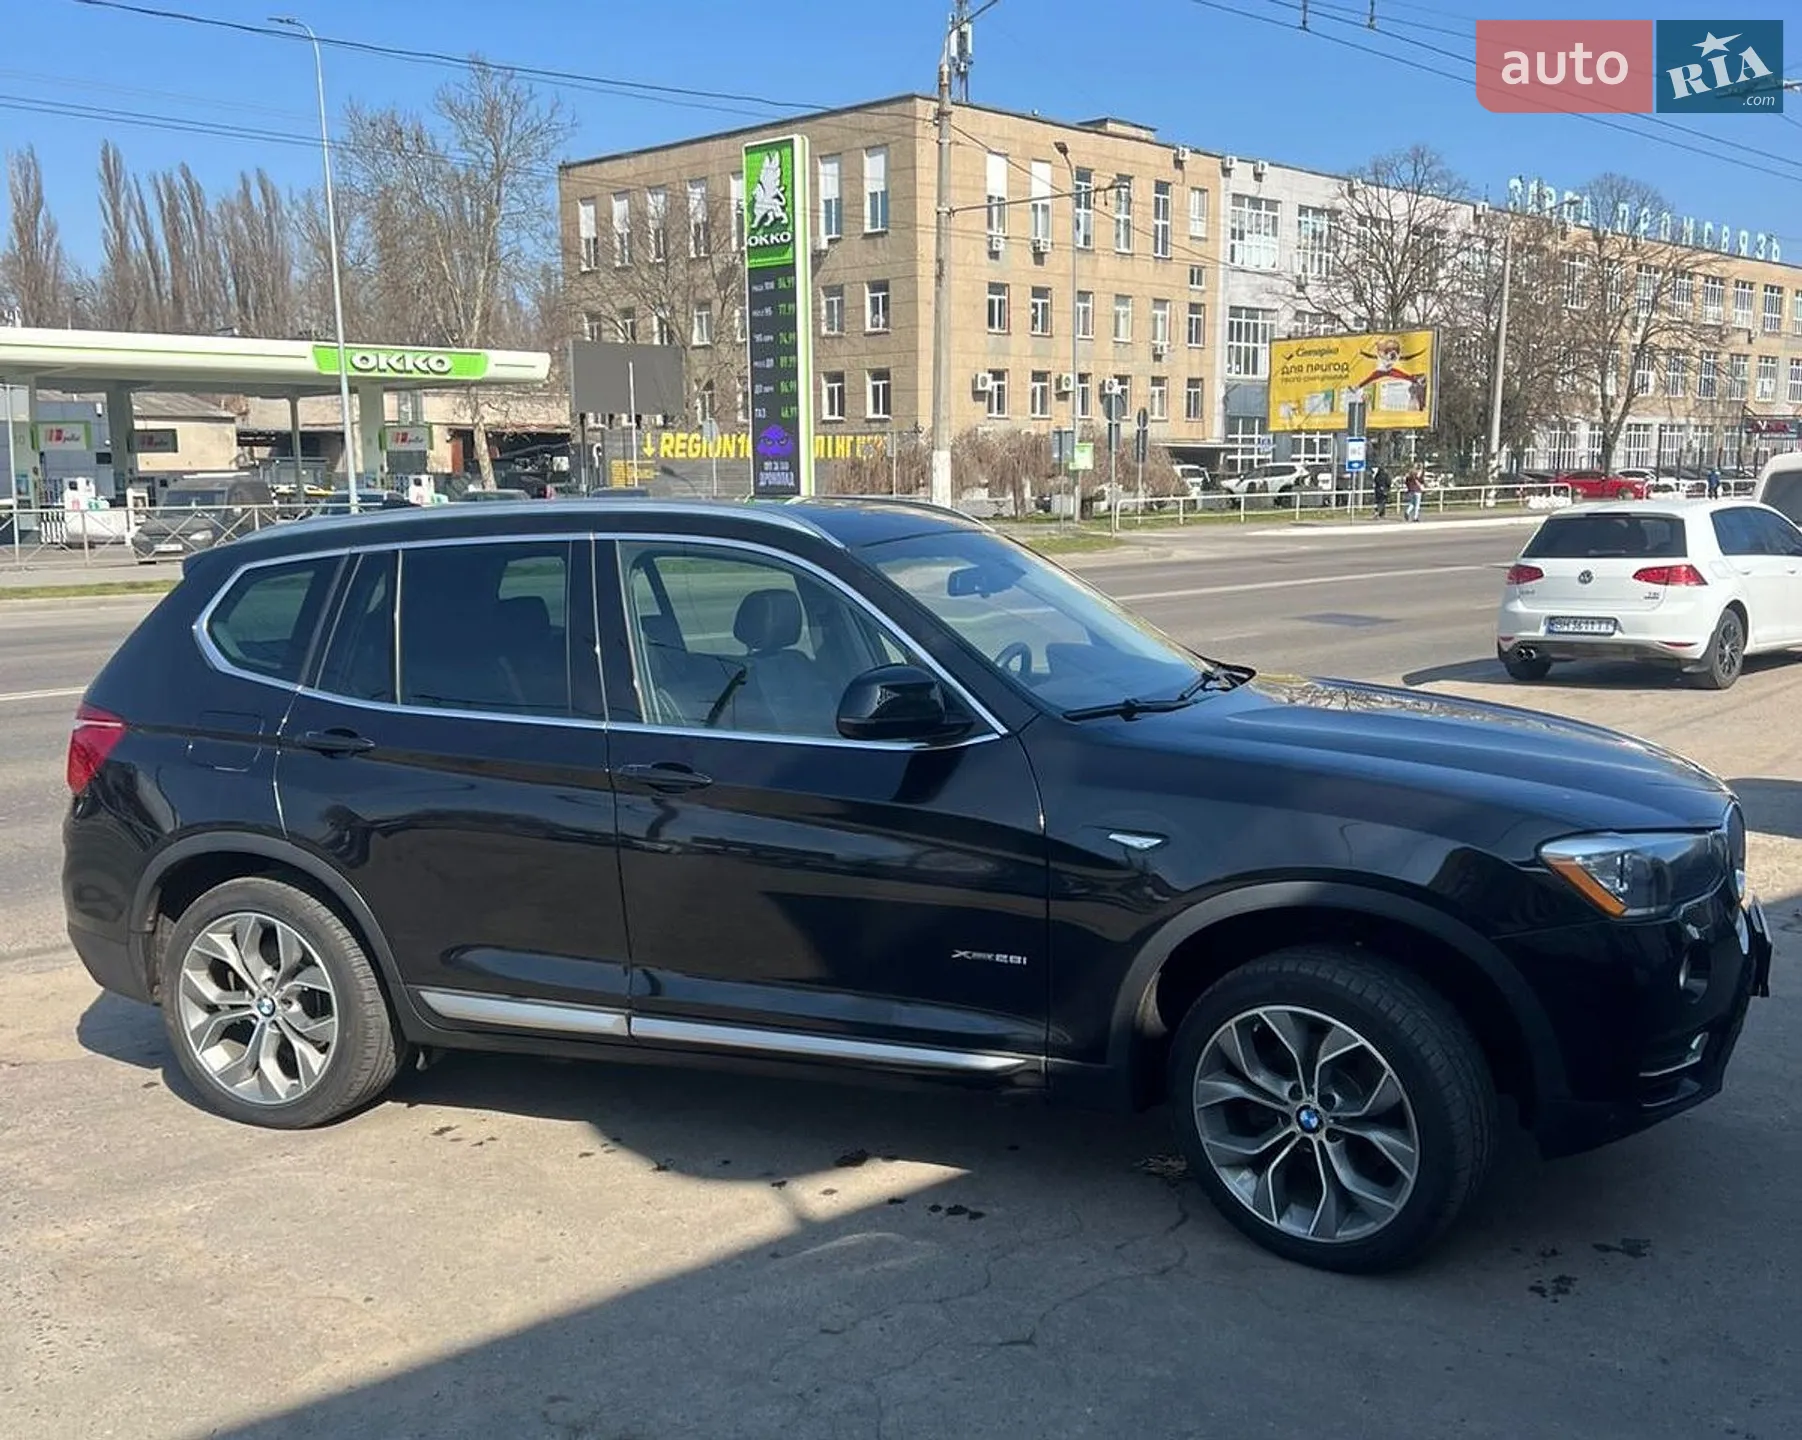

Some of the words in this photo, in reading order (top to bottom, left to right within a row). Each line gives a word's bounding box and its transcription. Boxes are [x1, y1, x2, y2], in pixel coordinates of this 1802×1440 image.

[747, 231, 792, 247] OKKO
[1616, 202, 1781, 262] ПРОМСВЯЗЬ
[350, 350, 454, 375] OKKO
[660, 432, 752, 459] REGION1
